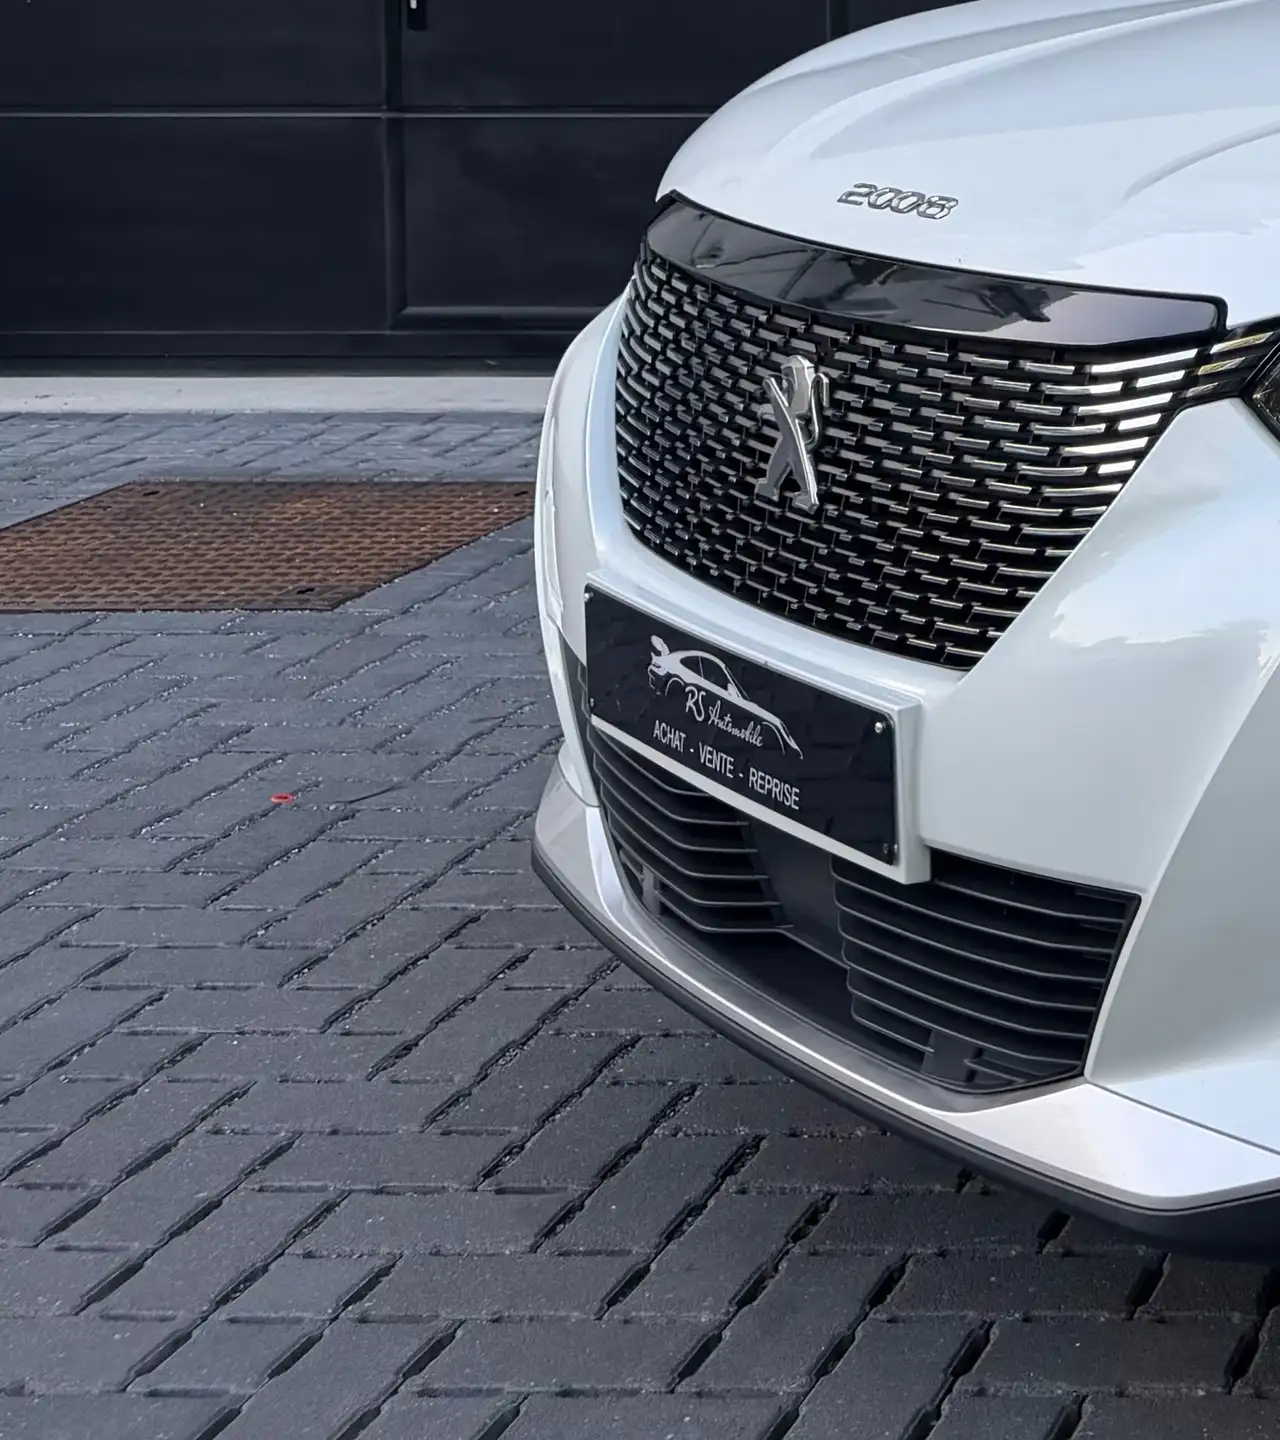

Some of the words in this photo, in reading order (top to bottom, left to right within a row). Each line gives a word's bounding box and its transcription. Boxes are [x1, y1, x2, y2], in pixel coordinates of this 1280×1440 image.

[836, 182, 959, 220] 2008
[684, 685, 707, 722] RS
[707, 699, 764, 747] Automobile
[653, 719, 687, 753] ACHAT
[698, 741, 735, 779] VENTE
[748, 766, 800, 810] REPRISE
